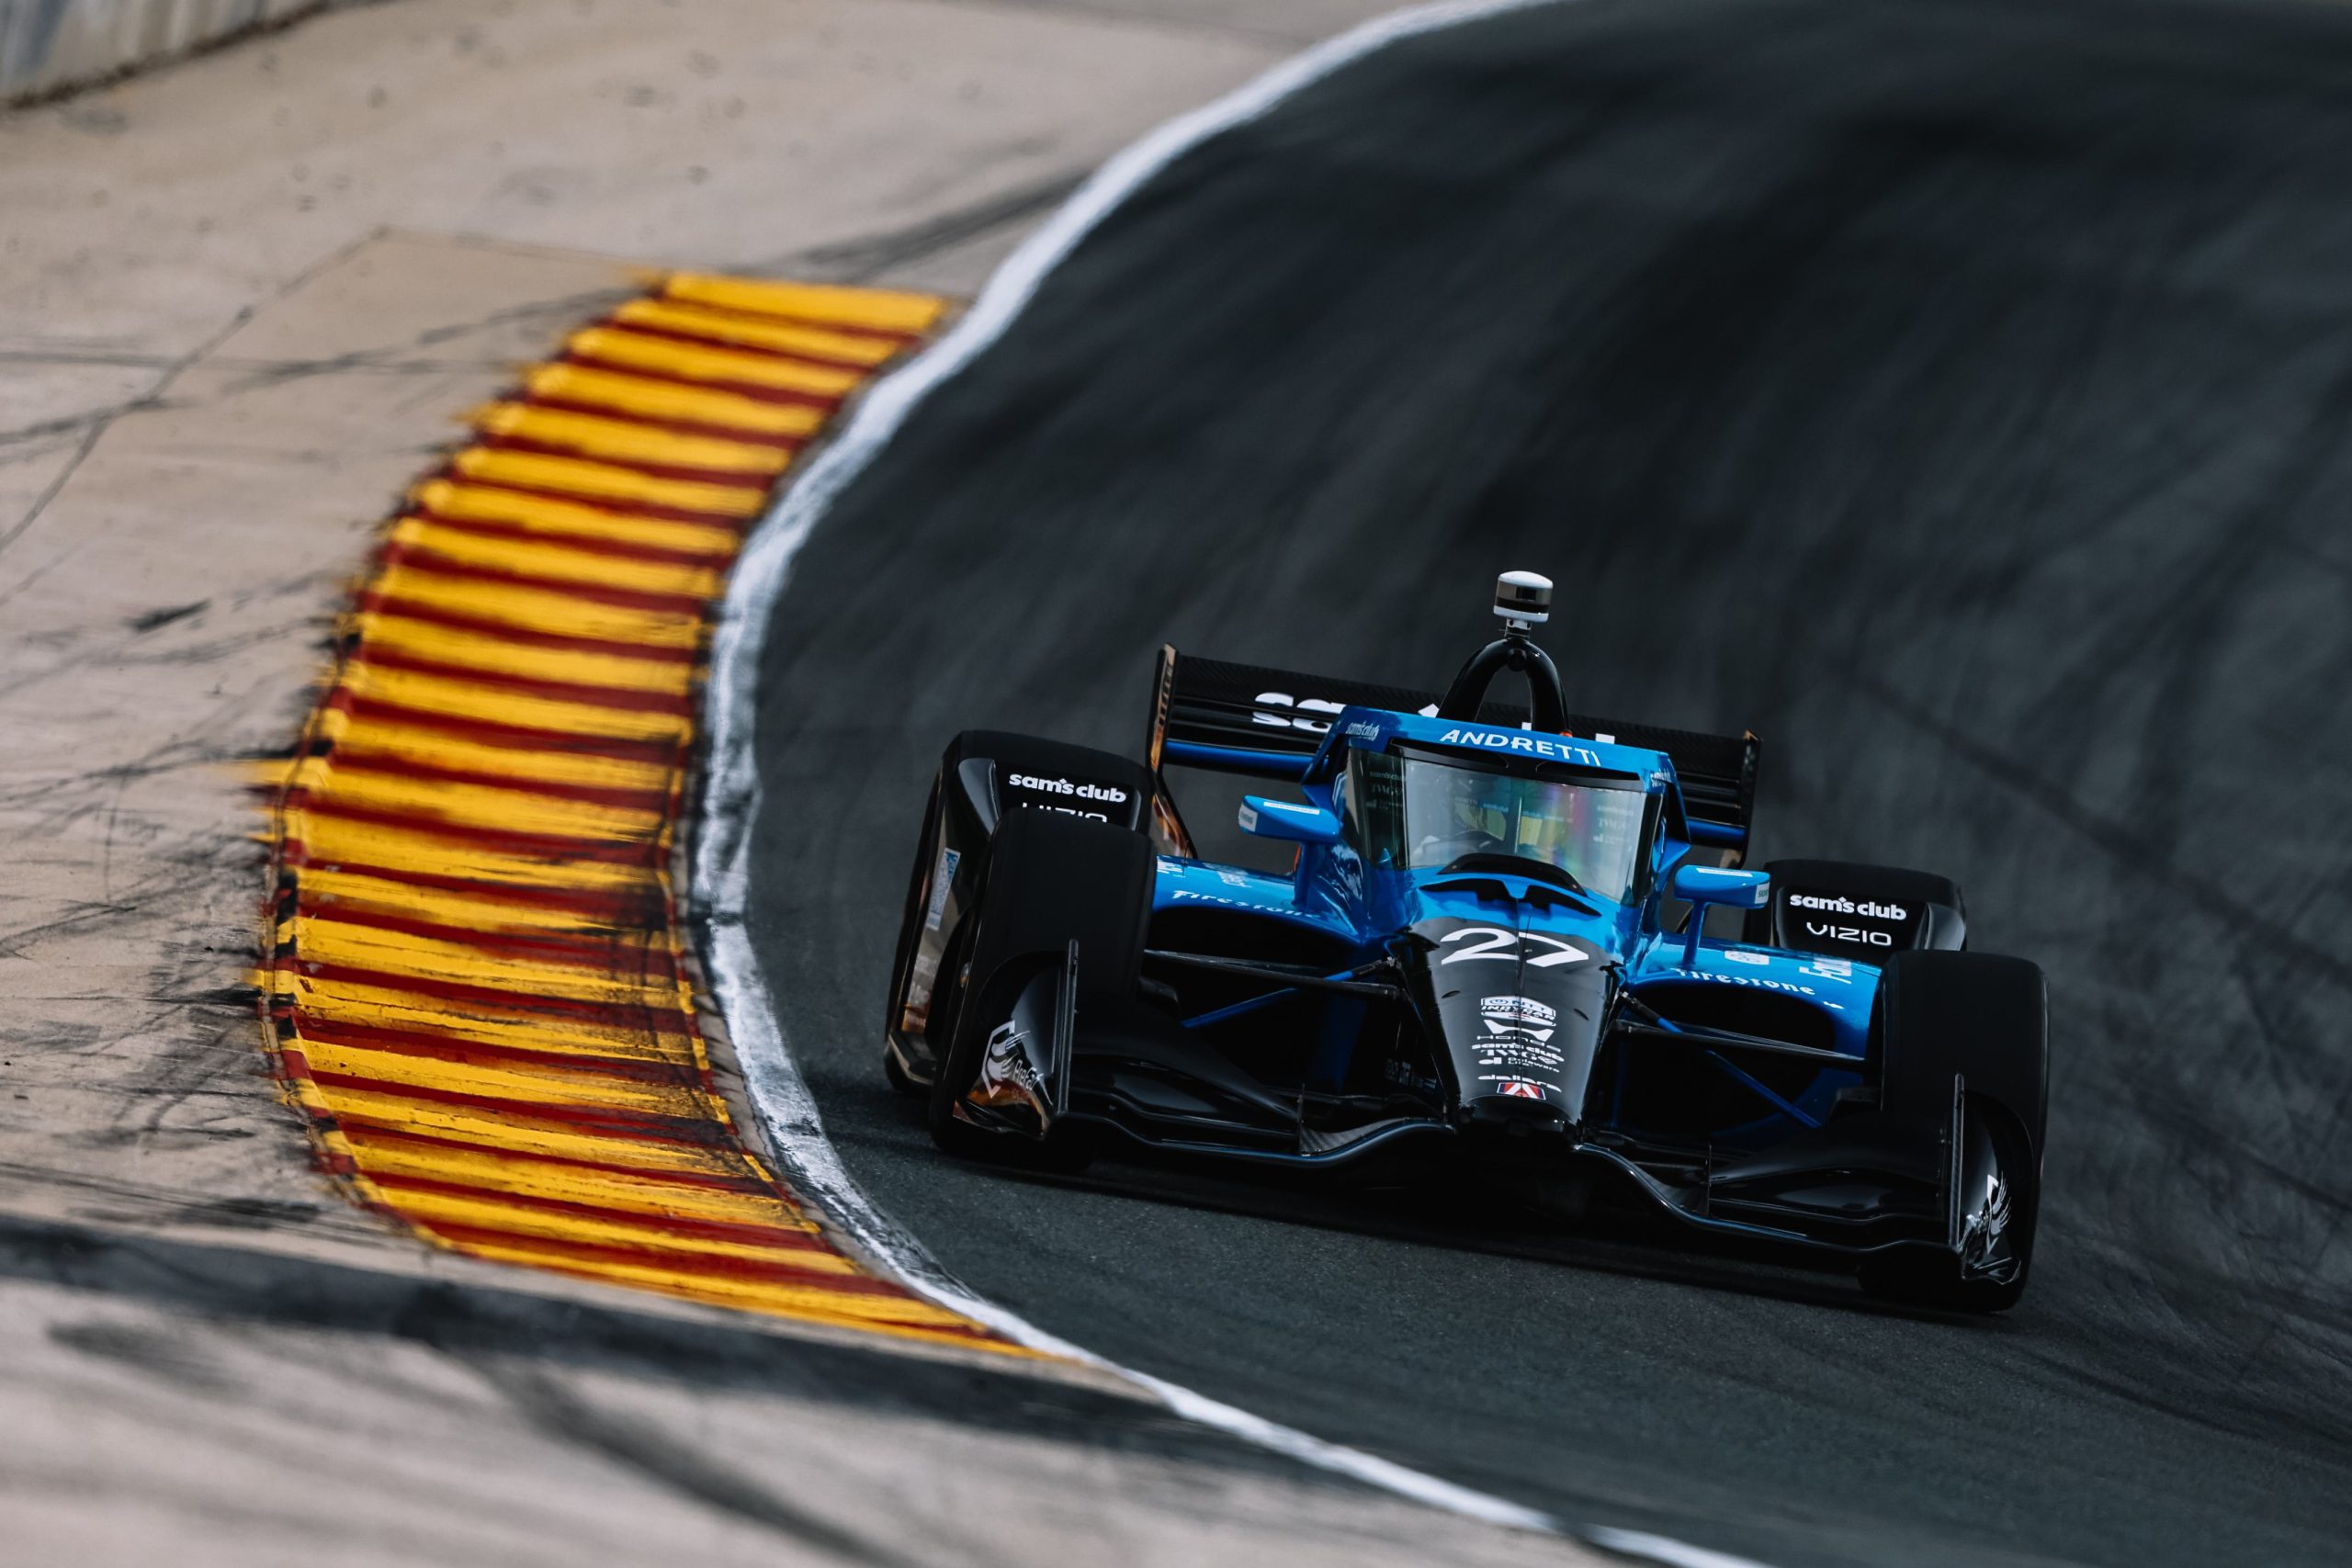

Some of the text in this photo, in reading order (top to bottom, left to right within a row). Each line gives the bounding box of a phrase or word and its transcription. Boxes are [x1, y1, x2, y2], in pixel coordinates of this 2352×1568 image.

[1440, 728, 1601, 767] ANDRETTI
[1009, 773, 1127, 803] sam's club
[1171, 889, 1322, 919] Firestone
[1790, 894, 1907, 920] sam's club
[1440, 927, 1589, 968] 27
[1806, 921, 1893, 946] VIZIO
[1669, 967, 1815, 996] Firestone
[1481, 1005, 1555, 1021] INDYCAR
